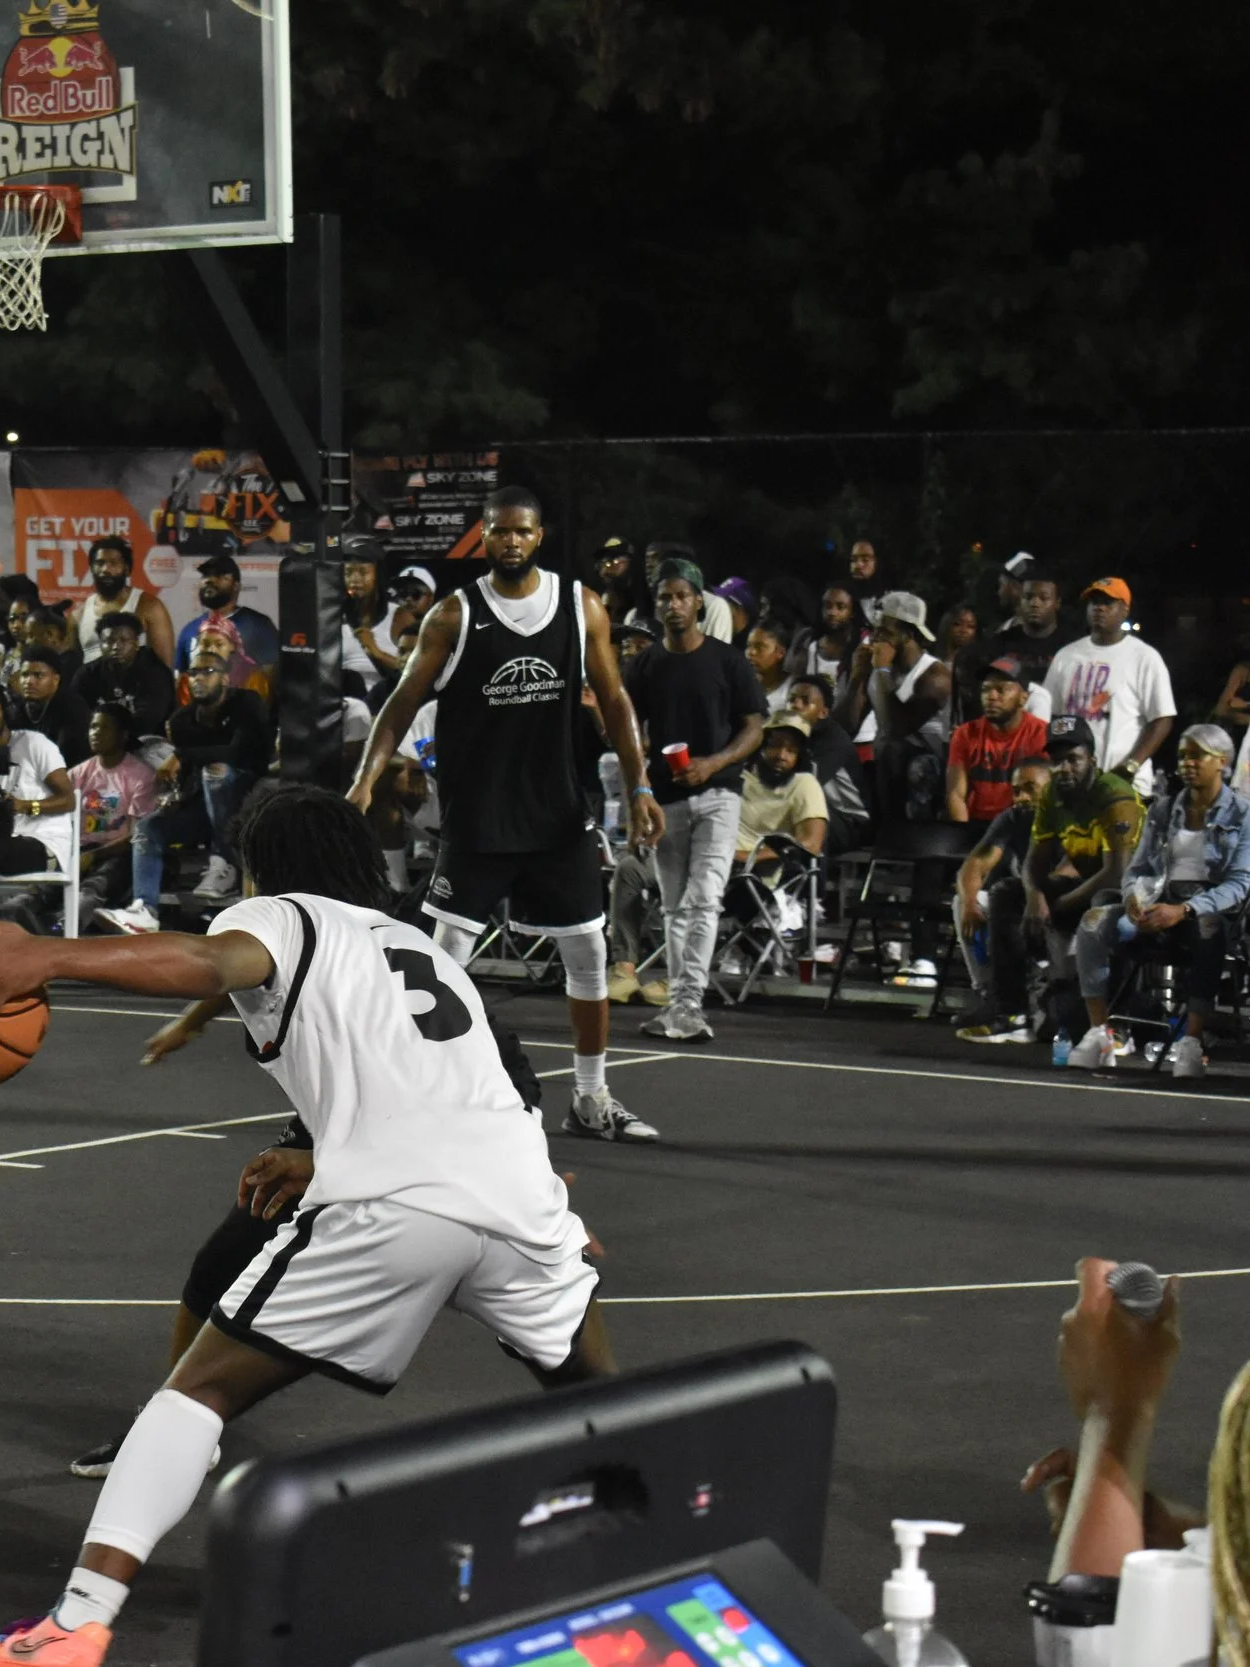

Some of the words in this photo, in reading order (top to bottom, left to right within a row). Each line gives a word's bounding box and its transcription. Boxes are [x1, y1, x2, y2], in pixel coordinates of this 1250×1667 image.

[7, 81, 59, 117] Red
[61, 76, 113, 113] Bull
[426, 471, 455, 484] SKY
[458, 470, 498, 482] ZONE
[26, 516, 65, 536] GET
[71, 516, 130, 536] YOUR
[394, 515, 421, 527] SKY
[425, 513, 465, 526] ZONE
[482, 684, 518, 696] George
[519, 680, 565, 693] Goodman
[489, 694, 531, 706] Roundball
[532, 692, 560, 702] Classic
[382, 946, 473, 1042] 3
